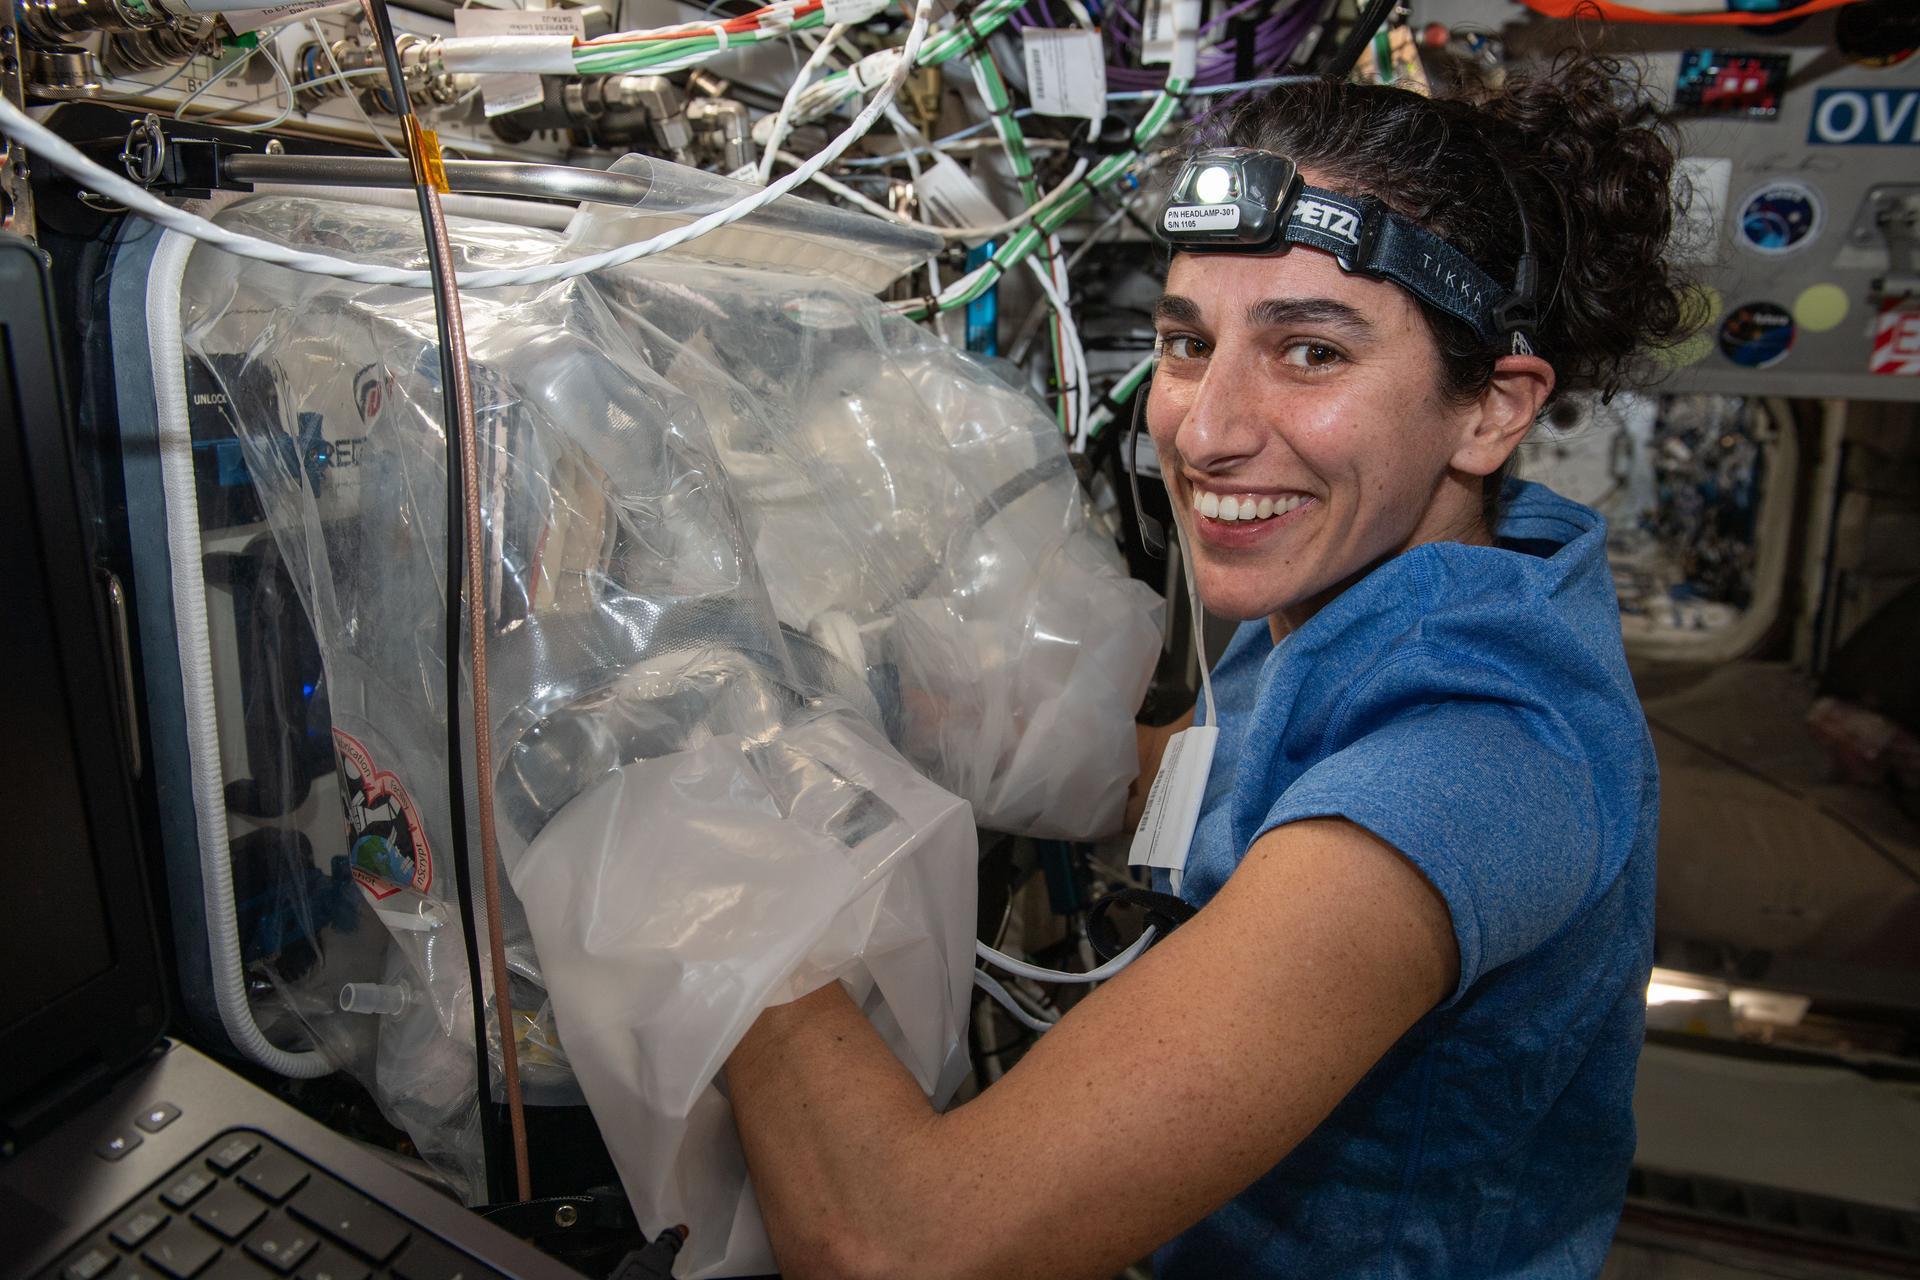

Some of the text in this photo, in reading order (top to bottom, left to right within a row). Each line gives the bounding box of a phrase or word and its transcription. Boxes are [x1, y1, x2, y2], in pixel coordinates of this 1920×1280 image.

[1815, 90, 1920, 143] OV
[1168, 208, 1235, 219] P/N HEADLAMP-301
[1167, 220, 1196, 229] S/N 1105
[1423, 253, 1482, 307] TIKKA
[193, 393, 228, 405] UNLOCK
